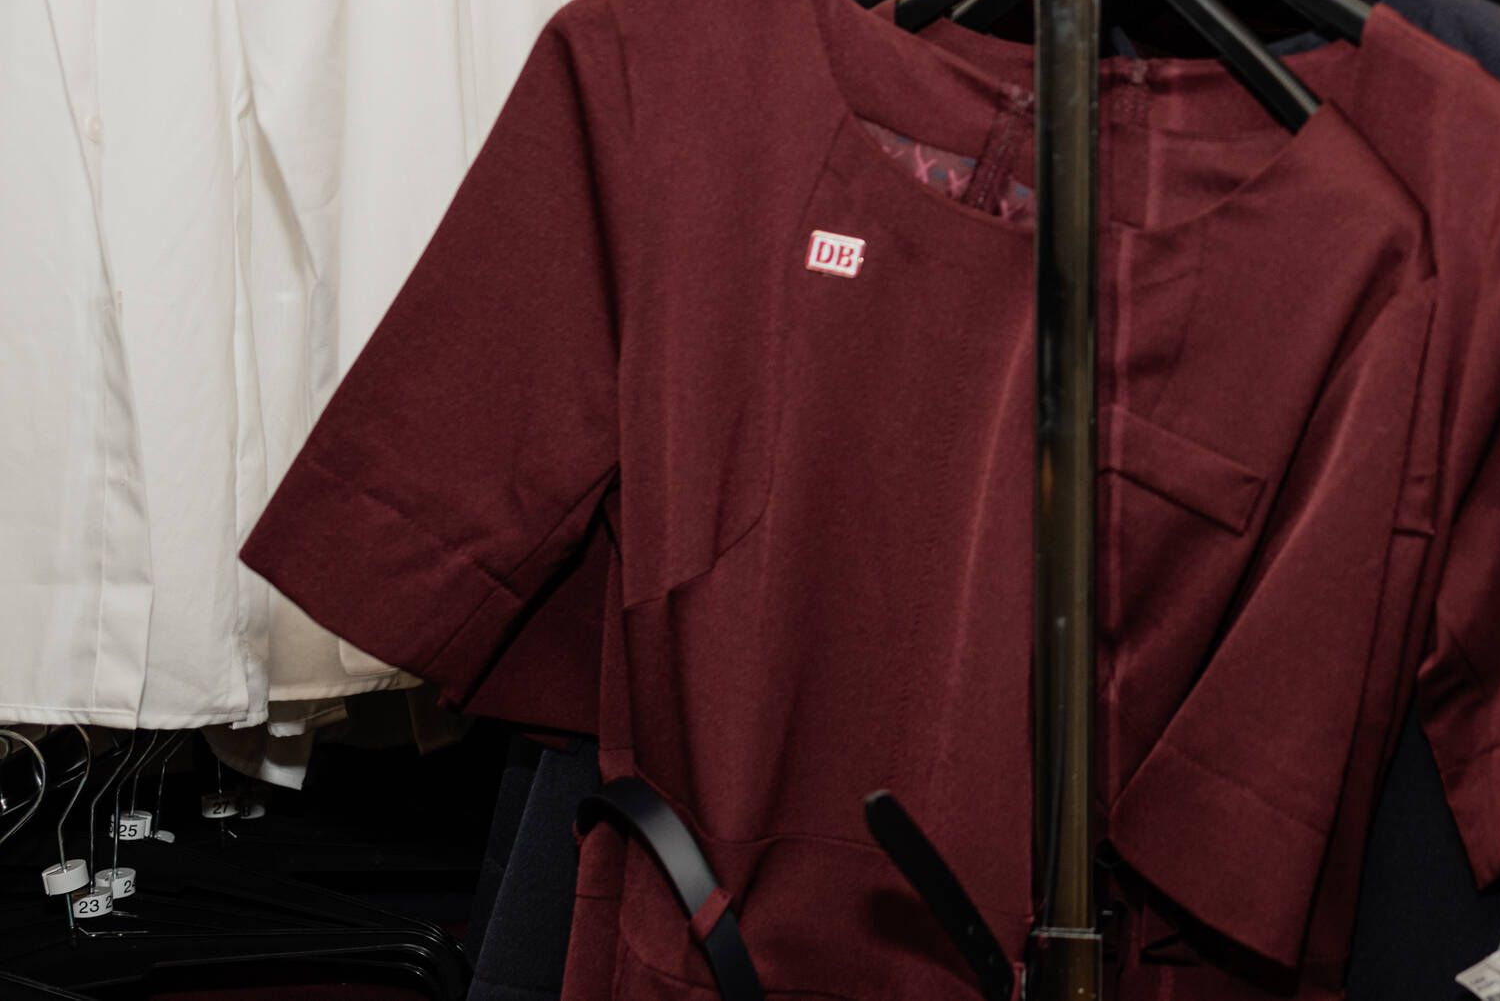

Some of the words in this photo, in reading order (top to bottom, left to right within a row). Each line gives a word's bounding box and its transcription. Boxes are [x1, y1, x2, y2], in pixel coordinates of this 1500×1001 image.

[815, 240, 855, 269] DB
[212, 802, 229, 815] 27
[119, 824, 138, 838] 25
[79, 899, 99, 914] 23
